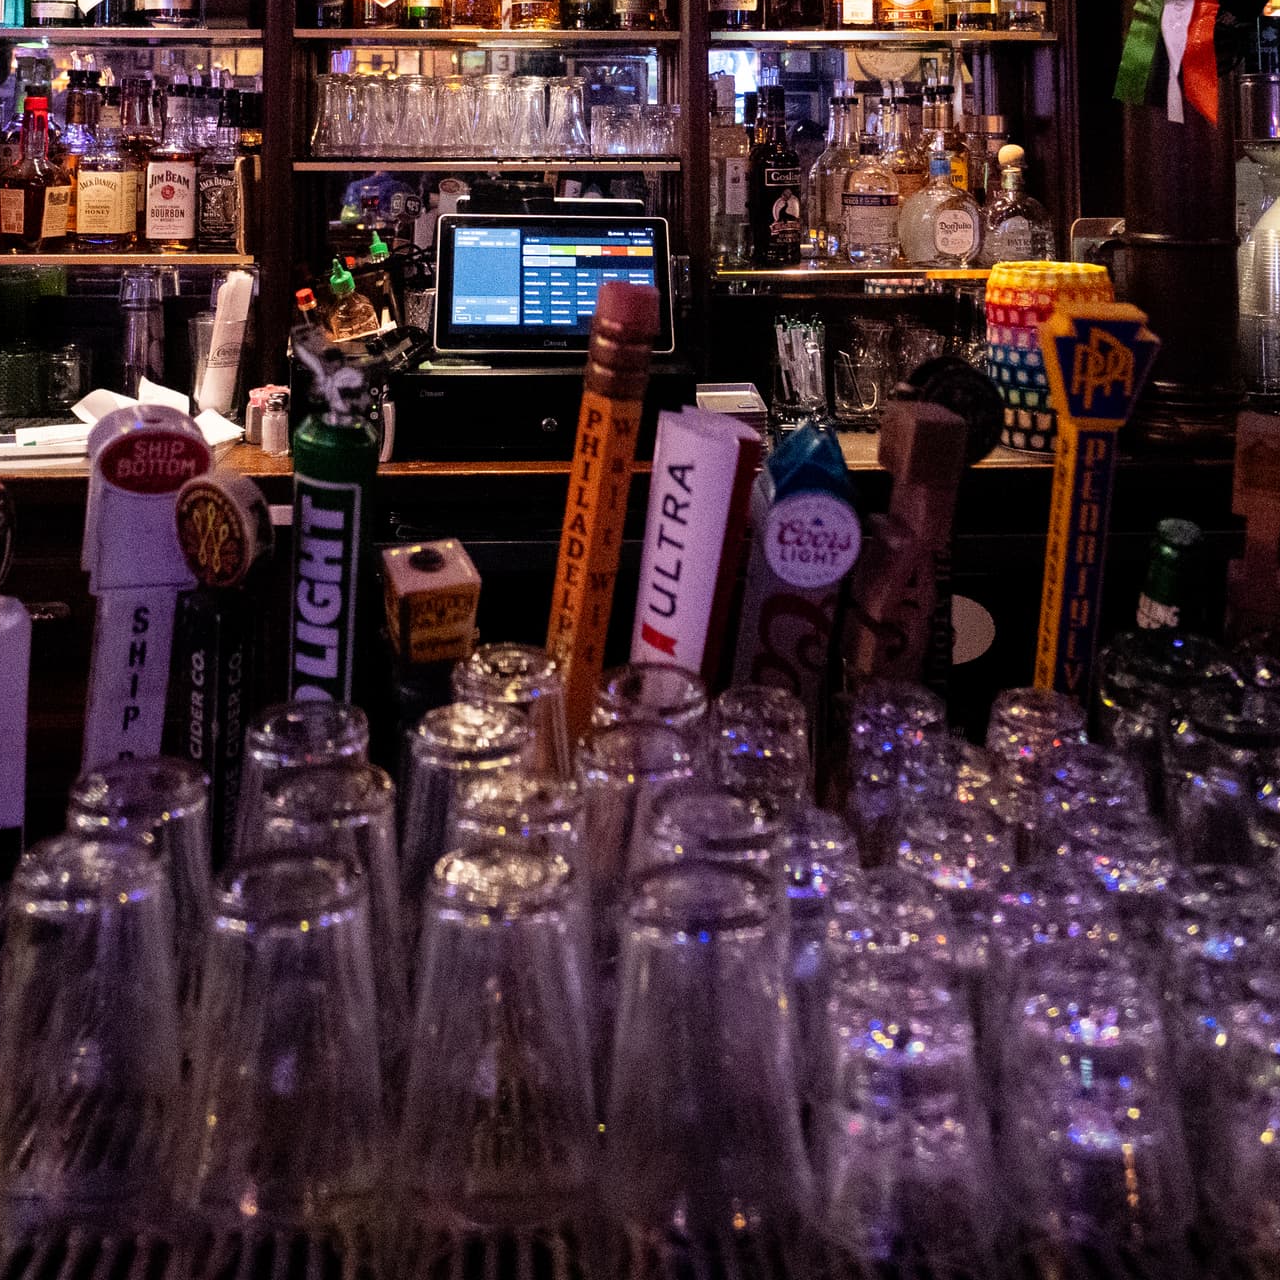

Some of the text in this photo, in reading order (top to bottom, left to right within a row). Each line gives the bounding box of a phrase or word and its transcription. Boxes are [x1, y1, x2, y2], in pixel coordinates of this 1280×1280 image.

[79, 179, 94, 191] JACK
[149, 170, 190, 189] JIM BEAM
[84, 209, 111, 217] HONEY
[151, 208, 185, 219] BOURBON
[134, 441, 185, 459] SHIP
[119, 456, 196, 477] BOTTOM
[648, 460, 696, 620] ULTRA
[779, 549, 841, 564] LIGHT
[294, 494, 346, 679] LIGHT
[188, 647, 206, 759] CIDER CO.
